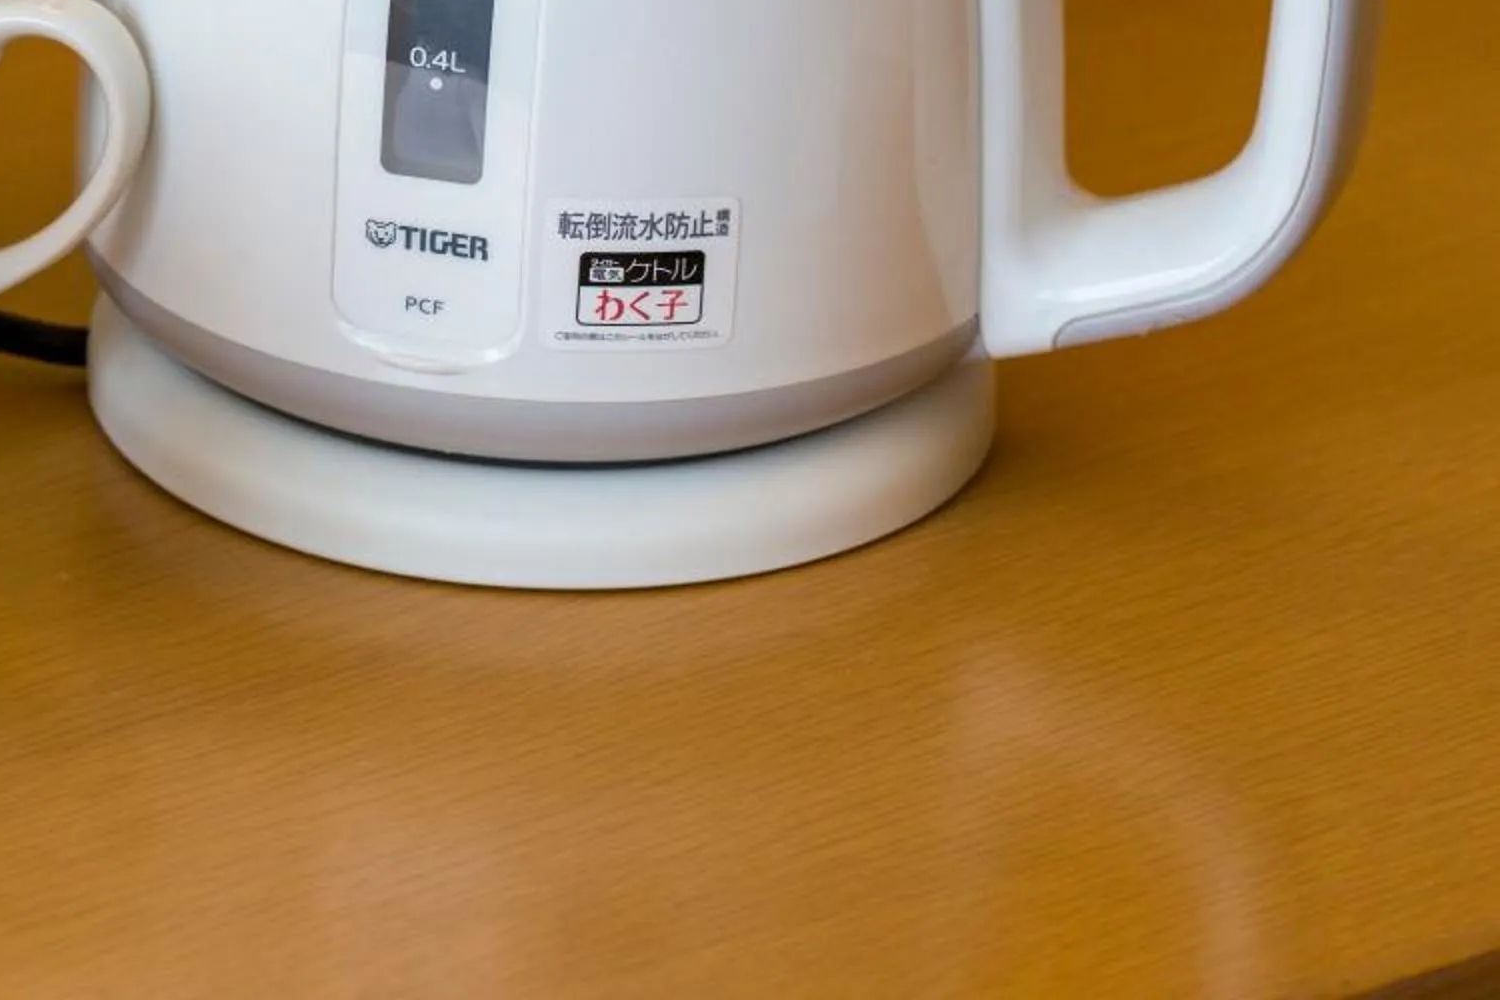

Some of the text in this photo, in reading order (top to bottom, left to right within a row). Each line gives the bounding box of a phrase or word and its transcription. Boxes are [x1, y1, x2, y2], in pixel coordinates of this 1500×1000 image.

[409, 46, 467, 73] 0.4L
[399, 226, 488, 261] TIGER
[405, 296, 445, 314] PCF
[595, 289, 688, 321] わく子
